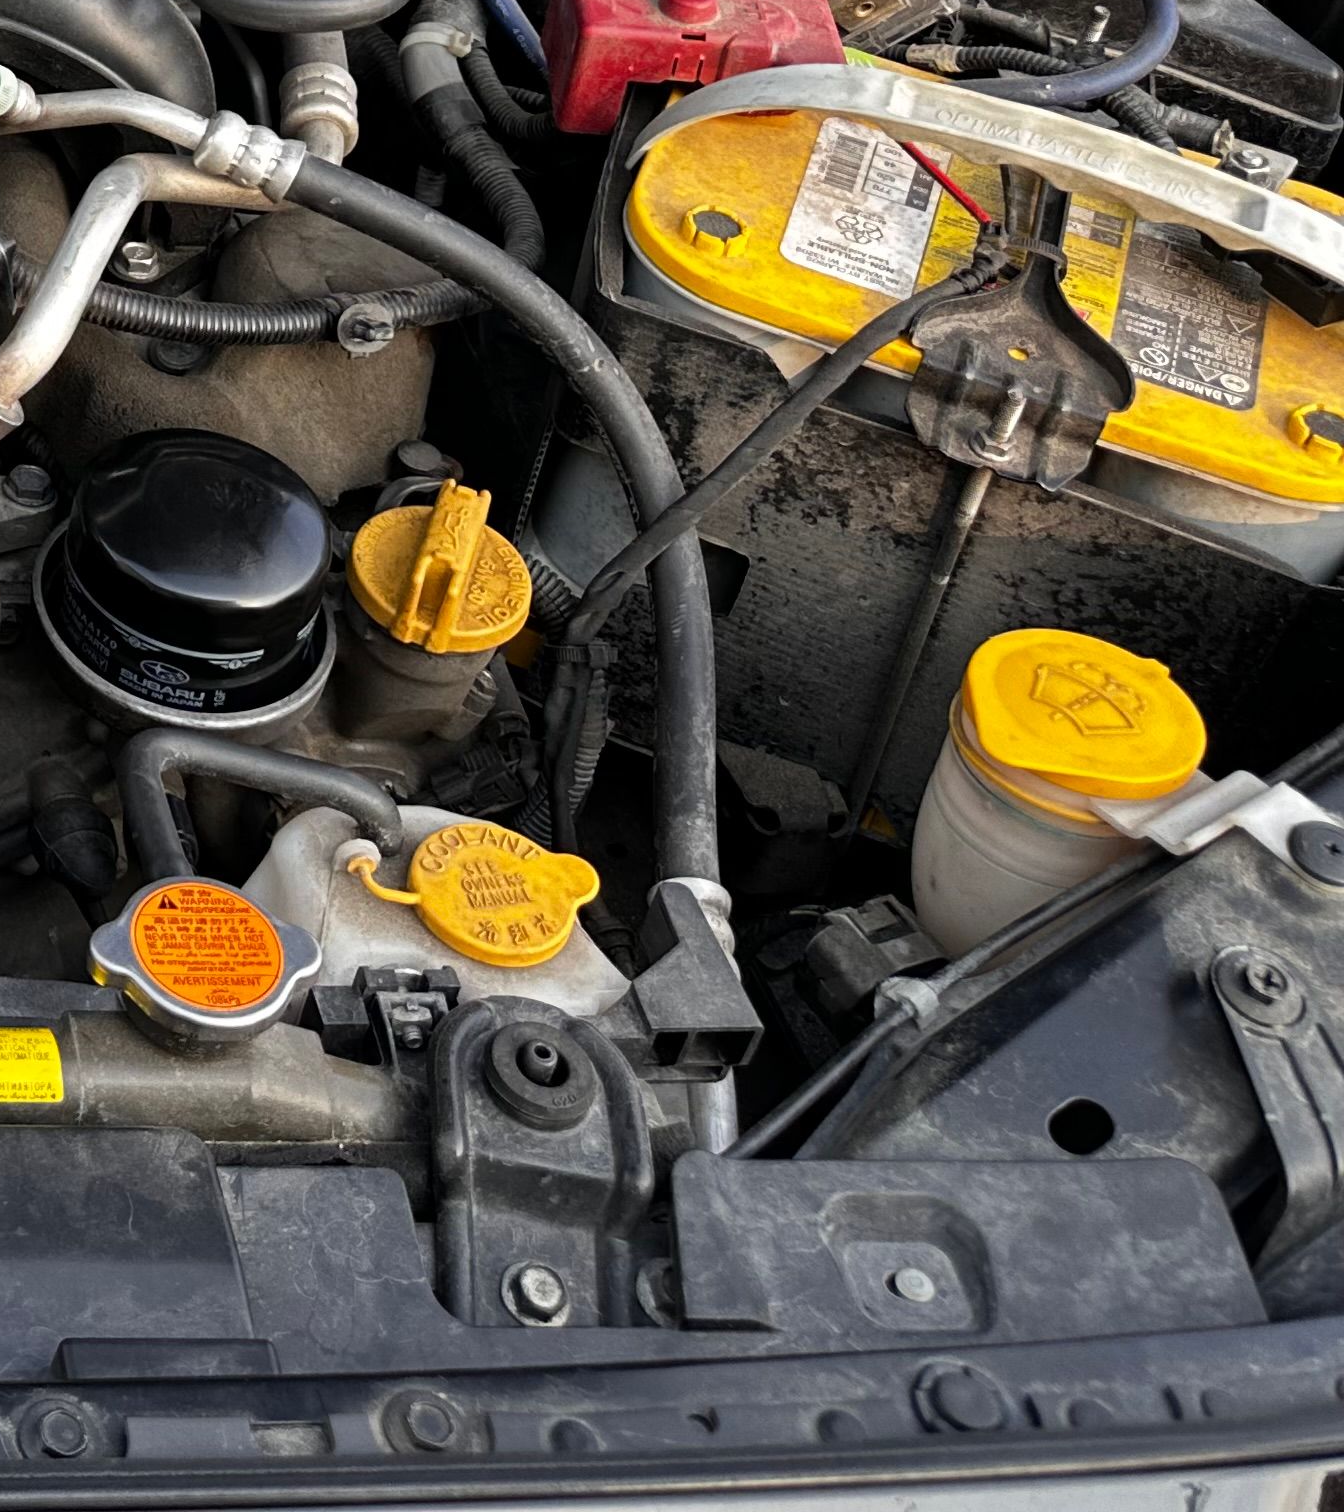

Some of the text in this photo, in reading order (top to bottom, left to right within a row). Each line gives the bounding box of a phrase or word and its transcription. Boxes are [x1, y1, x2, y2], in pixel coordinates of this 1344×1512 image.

[935, 107, 1022, 143] OPTIMA
[1151, 341, 1170, 352] NO
[1130, 362, 1222, 401] DANGER/POIS
[476, 545, 529, 629] ENGINE OIL
[119, 667, 206, 701] SUBARU
[165, 696, 204, 708] JAPAN
[419, 826, 541, 873] COOLANT
[178, 897, 236, 906] WARNING
[467, 888, 533, 910] MANUAL
[144, 934, 265, 943] NEVER OPEN WHEN HOT
[147, 942, 158, 950] NE
[160, 942, 192, 950] JAMAIS
[172, 976, 262, 986] AVERTISSEMENT
